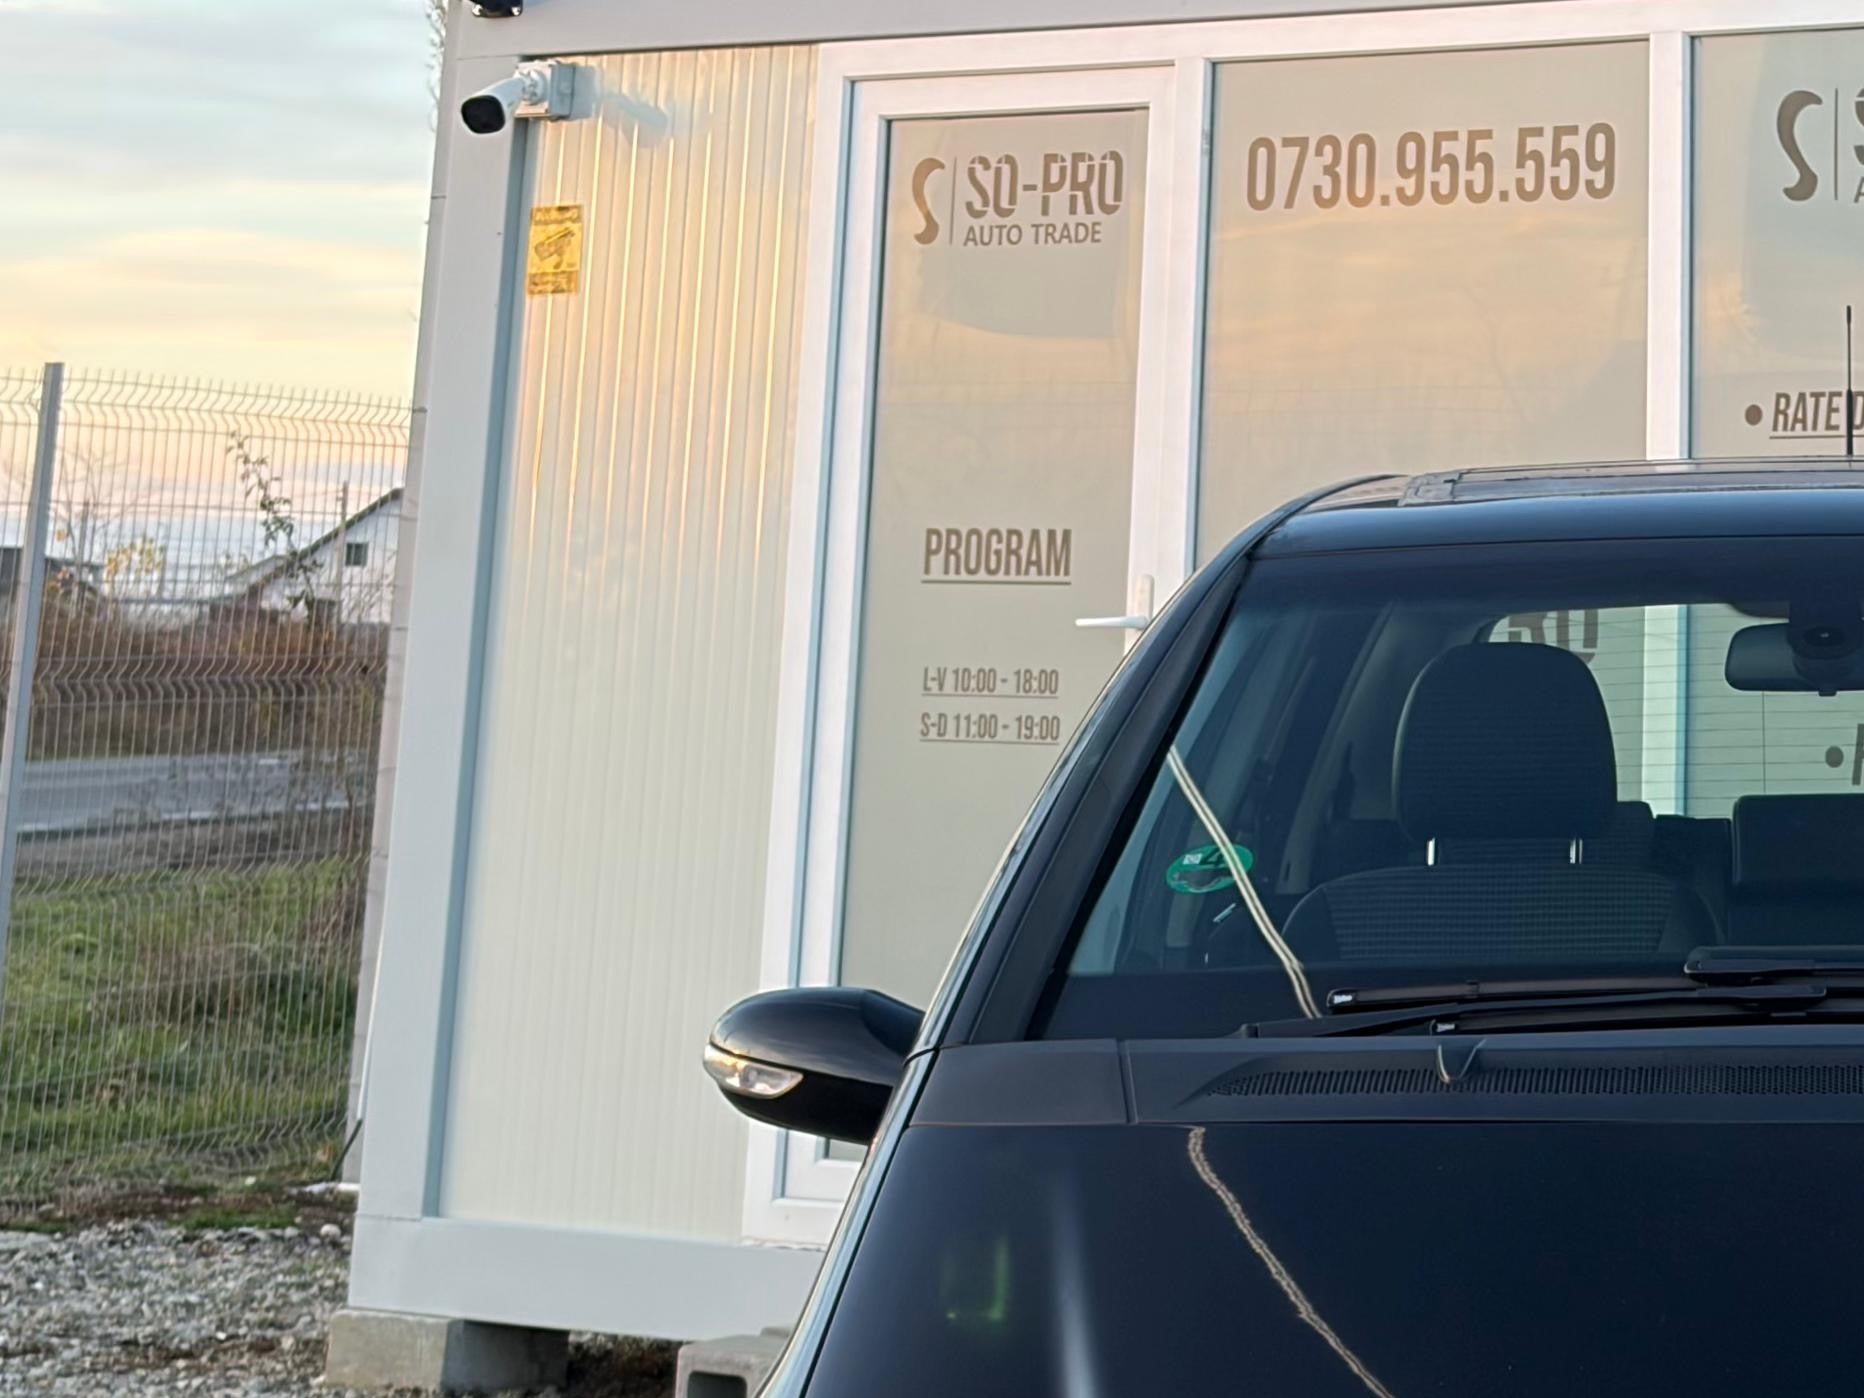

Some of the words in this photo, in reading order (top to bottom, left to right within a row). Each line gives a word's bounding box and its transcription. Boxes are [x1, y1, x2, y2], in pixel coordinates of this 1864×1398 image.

[964, 150, 1124, 219] SO-PRO
[1247, 122, 1616, 211] 0730.955.559
[963, 225, 1023, 247] AUTO
[1031, 222, 1102, 245] TRADE
[1772, 391, 1842, 431] RATE
[923, 528, 1072, 577] PROGRAM
[923, 667, 947, 692] L-V
[952, 668, 997, 693] 10:00
[1013, 669, 1059, 695] 18:00
[920, 712, 948, 738] S-D
[953, 713, 998, 740] 11:00
[1015, 715, 1060, 741] 19:00
